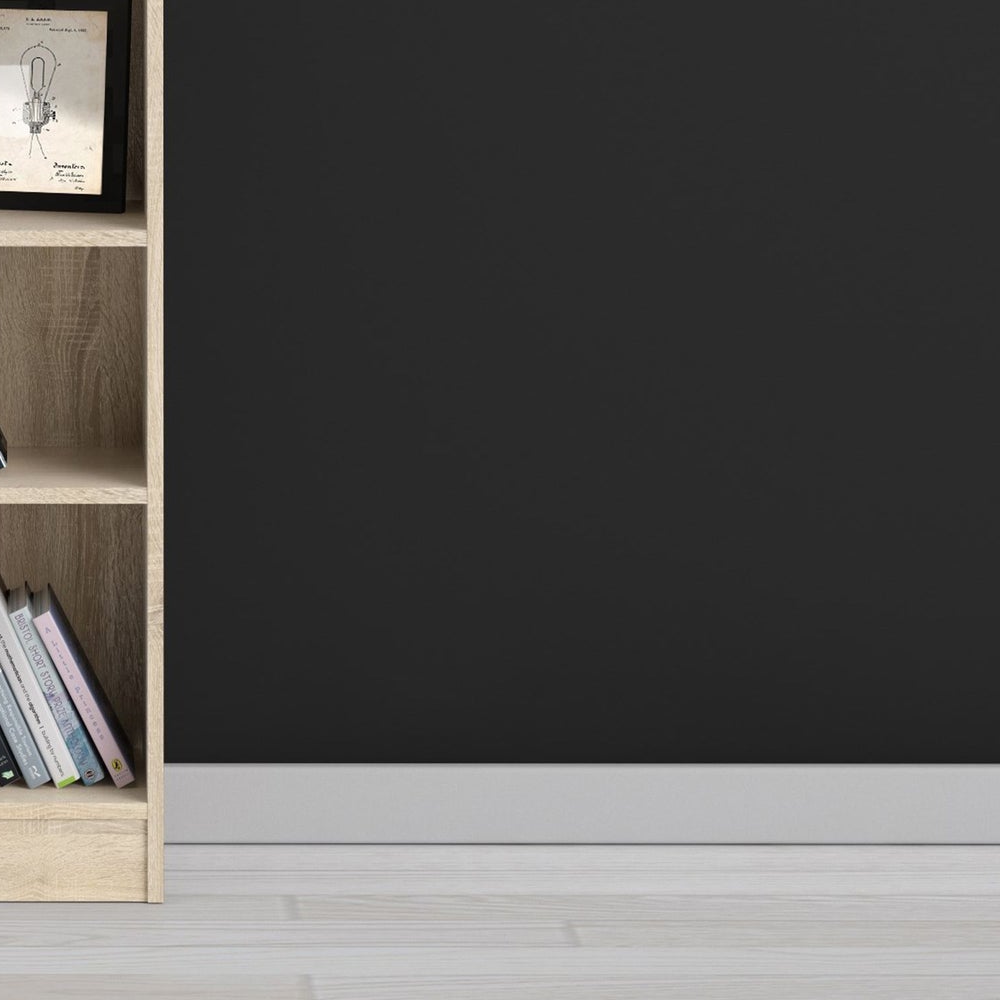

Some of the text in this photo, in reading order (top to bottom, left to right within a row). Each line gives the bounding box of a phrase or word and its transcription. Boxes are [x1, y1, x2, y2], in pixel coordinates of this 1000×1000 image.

[3, 648, 23, 683] mathematician
[14, 612, 34, 643] BRISTOL
[28, 643, 46, 670] SHORT
[51, 695, 67, 718] PRIZE
